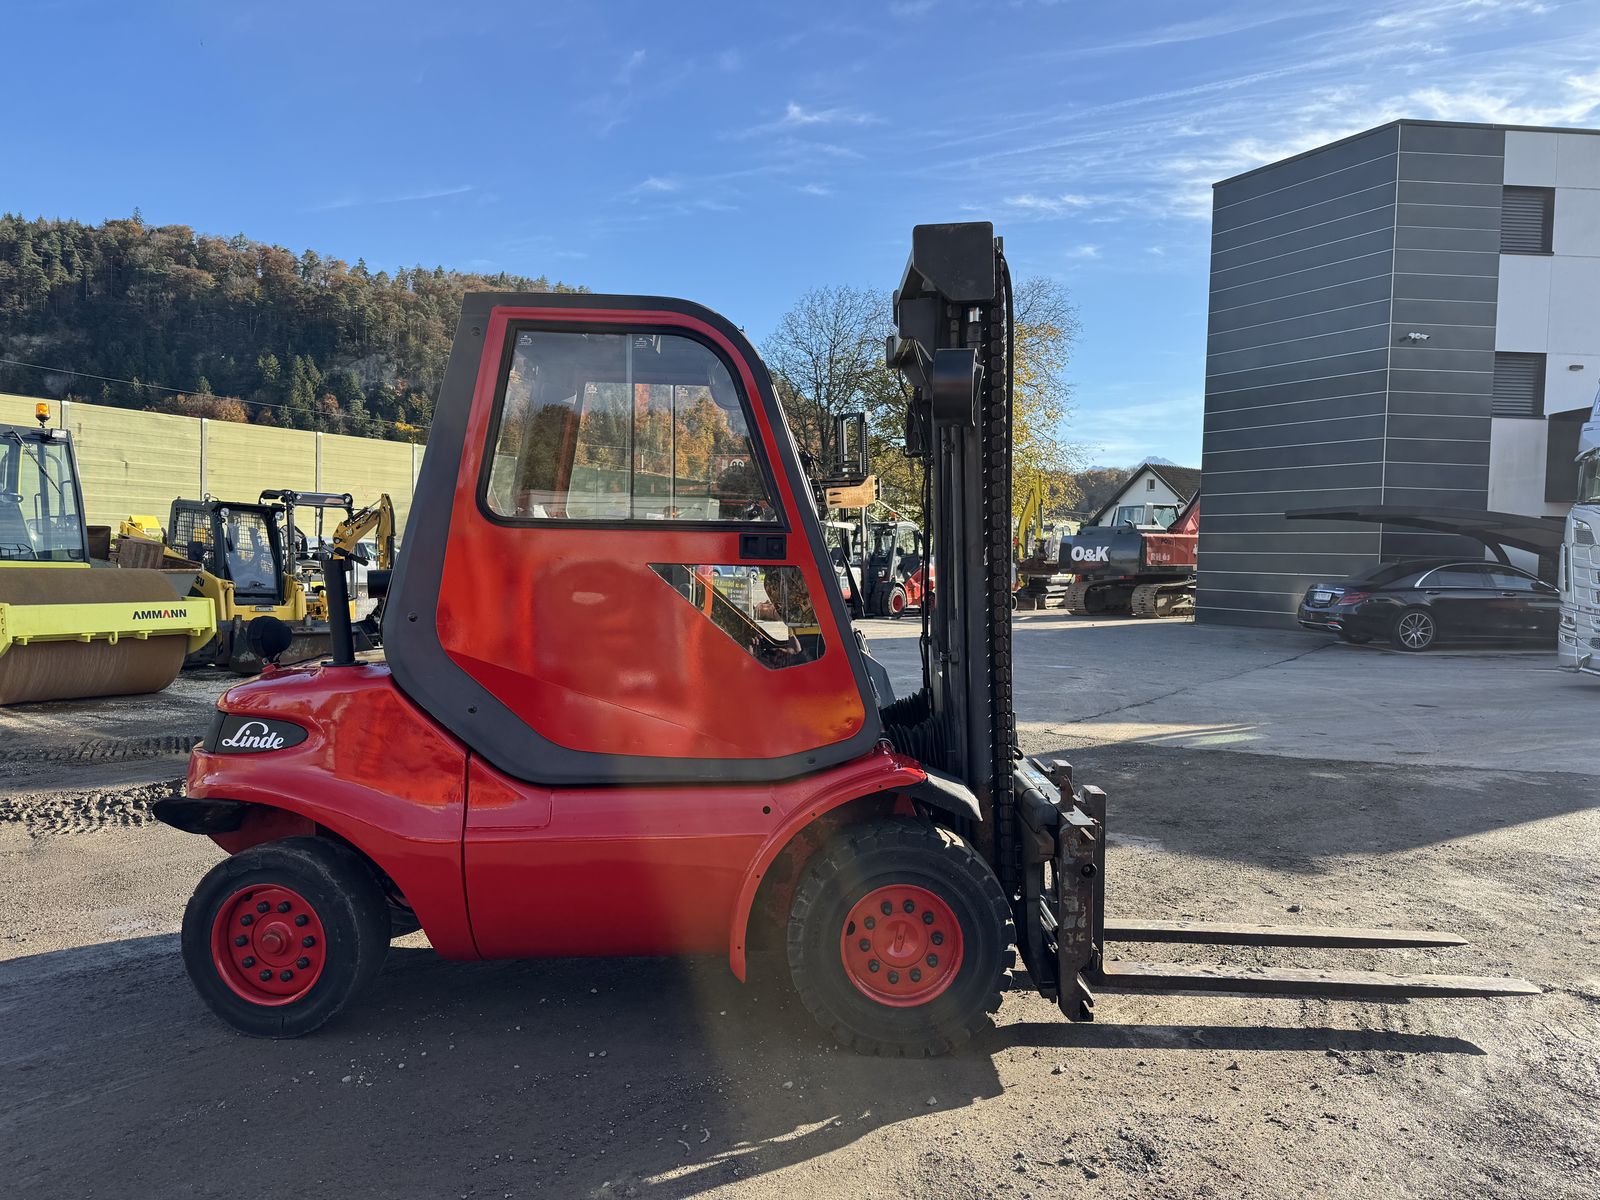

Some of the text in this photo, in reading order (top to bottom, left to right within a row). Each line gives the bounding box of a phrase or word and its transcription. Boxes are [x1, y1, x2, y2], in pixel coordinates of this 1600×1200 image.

[1071, 546, 1109, 561] O&K
[132, 609, 187, 620] AMMANN
[221, 721, 284, 749] Linde
